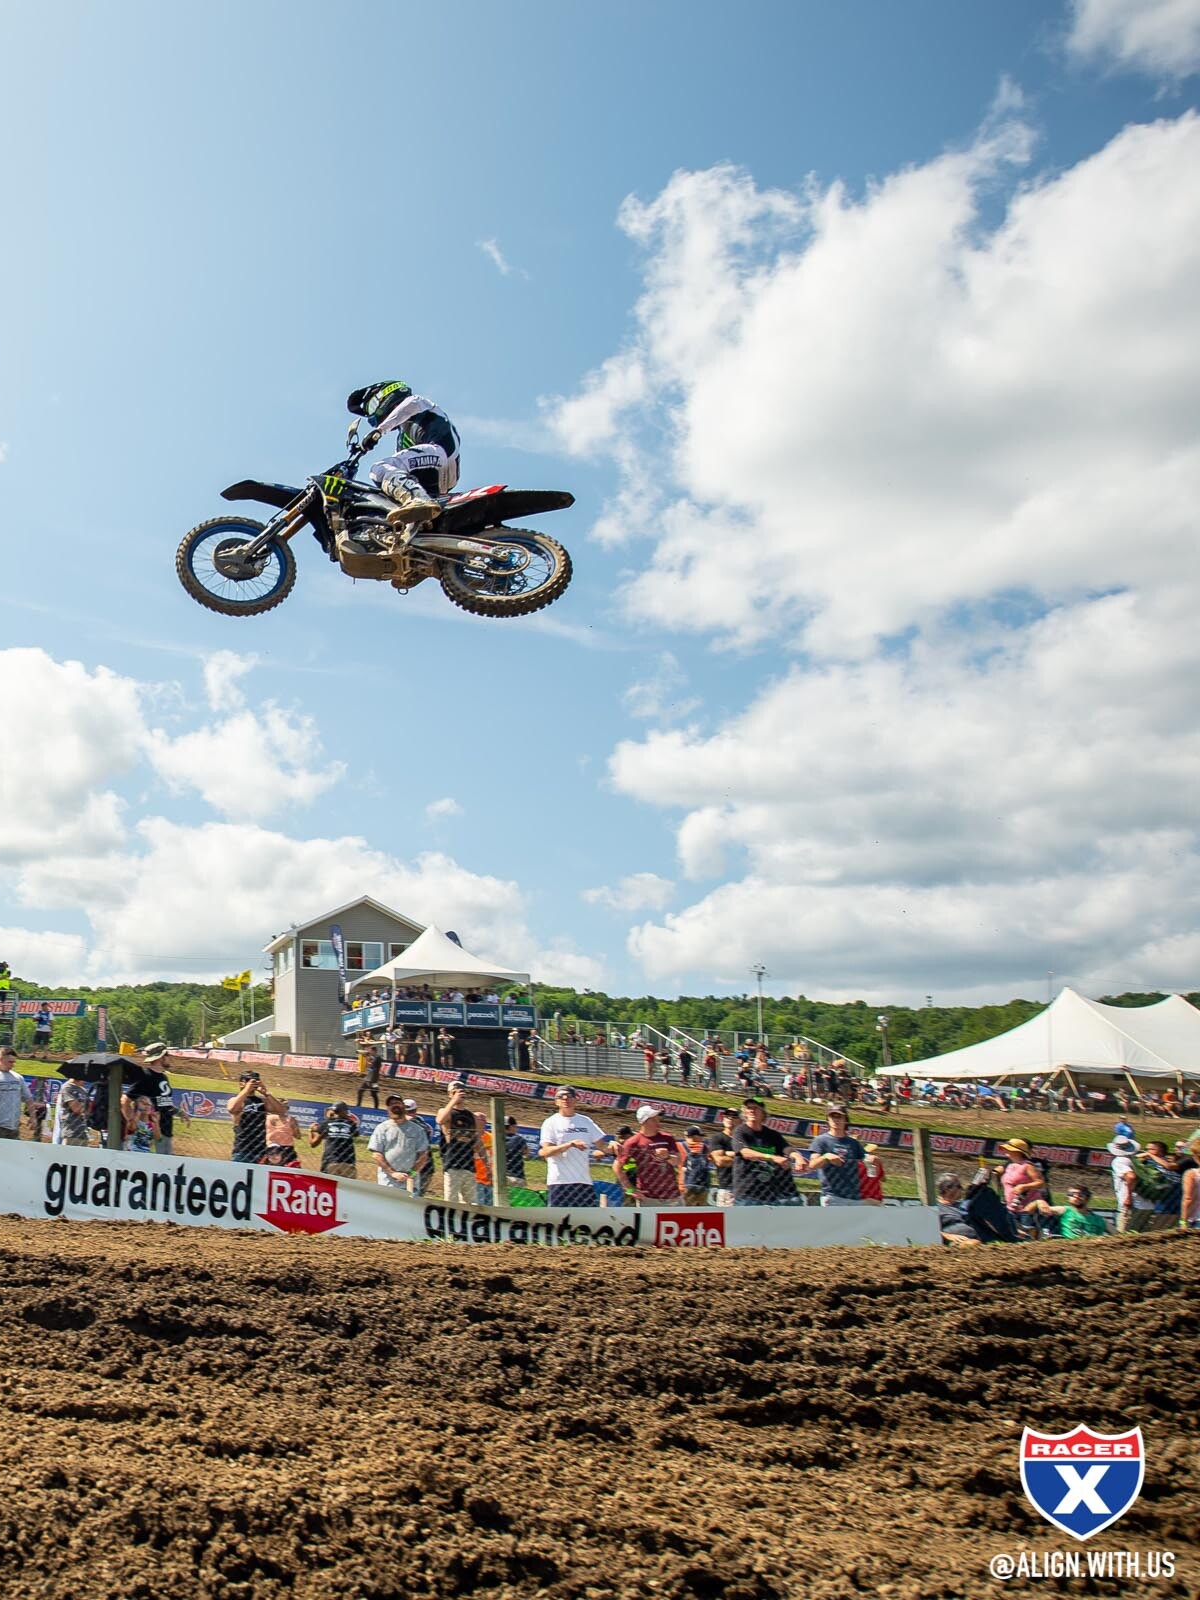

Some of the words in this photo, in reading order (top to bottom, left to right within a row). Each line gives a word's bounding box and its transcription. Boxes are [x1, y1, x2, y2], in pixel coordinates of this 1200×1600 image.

[415, 455, 442, 468] YAMAHA
[44, 1162, 254, 1221] guaranteed
[271, 1179, 334, 1217] Rate
[660, 1220, 722, 1248] Rate
